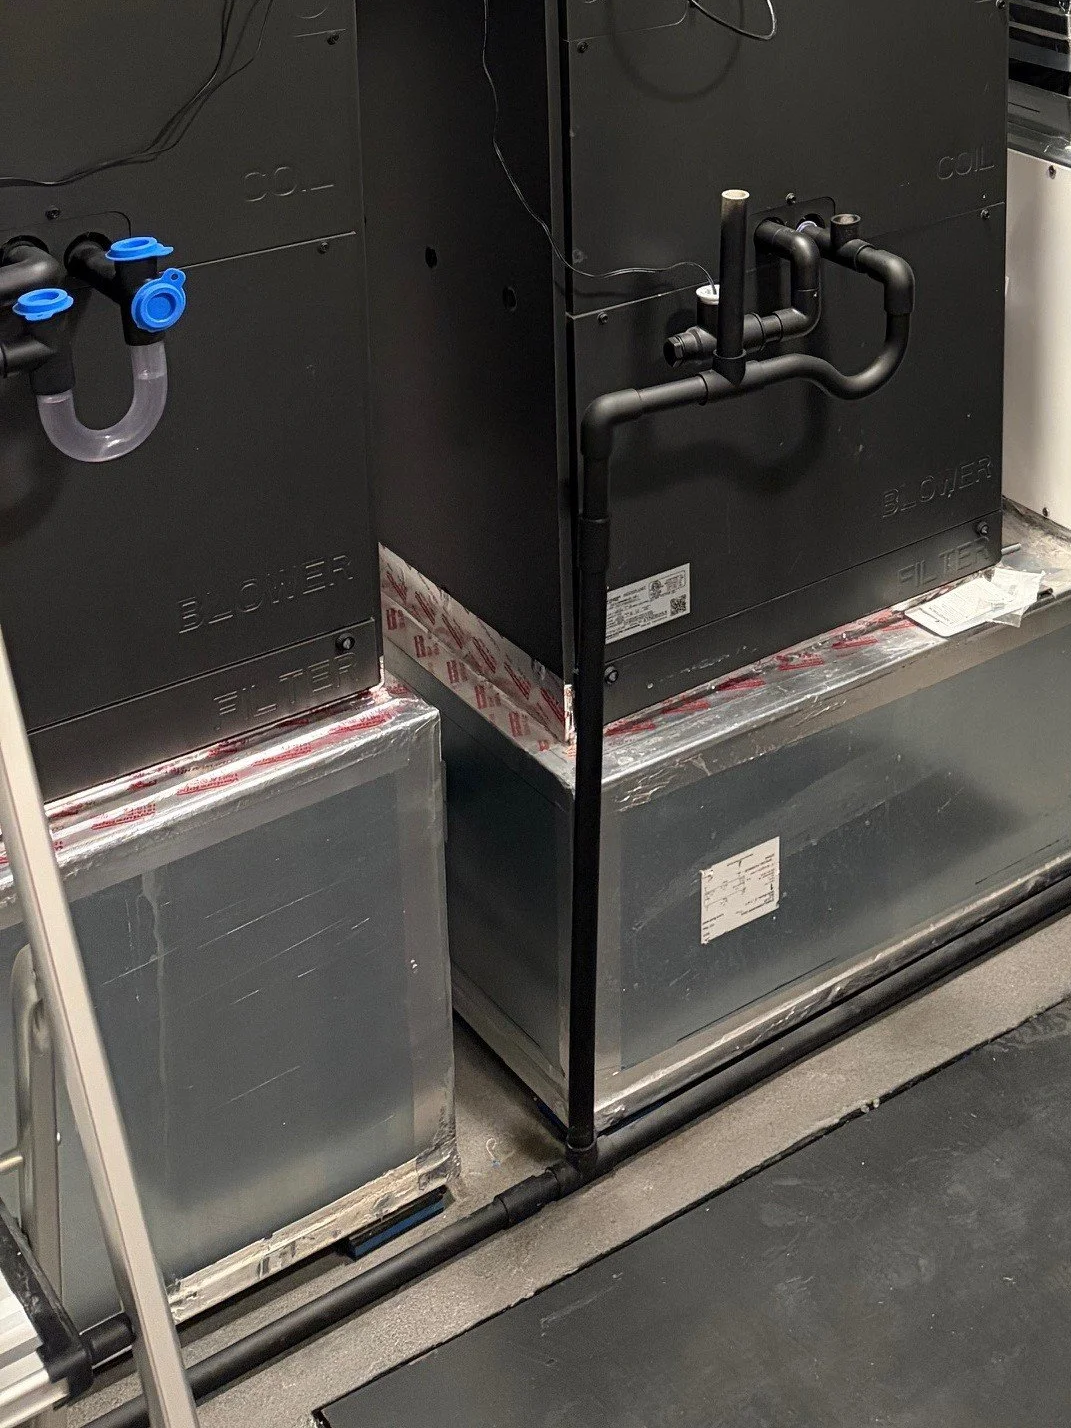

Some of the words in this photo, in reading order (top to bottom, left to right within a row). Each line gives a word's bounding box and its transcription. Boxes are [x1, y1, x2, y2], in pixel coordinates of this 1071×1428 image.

[882, 455, 991, 518] BLOWER
[178, 554, 353, 633] BLOWER
[898, 536, 992, 590] FILTER
[213, 652, 357, 730] FILTER
